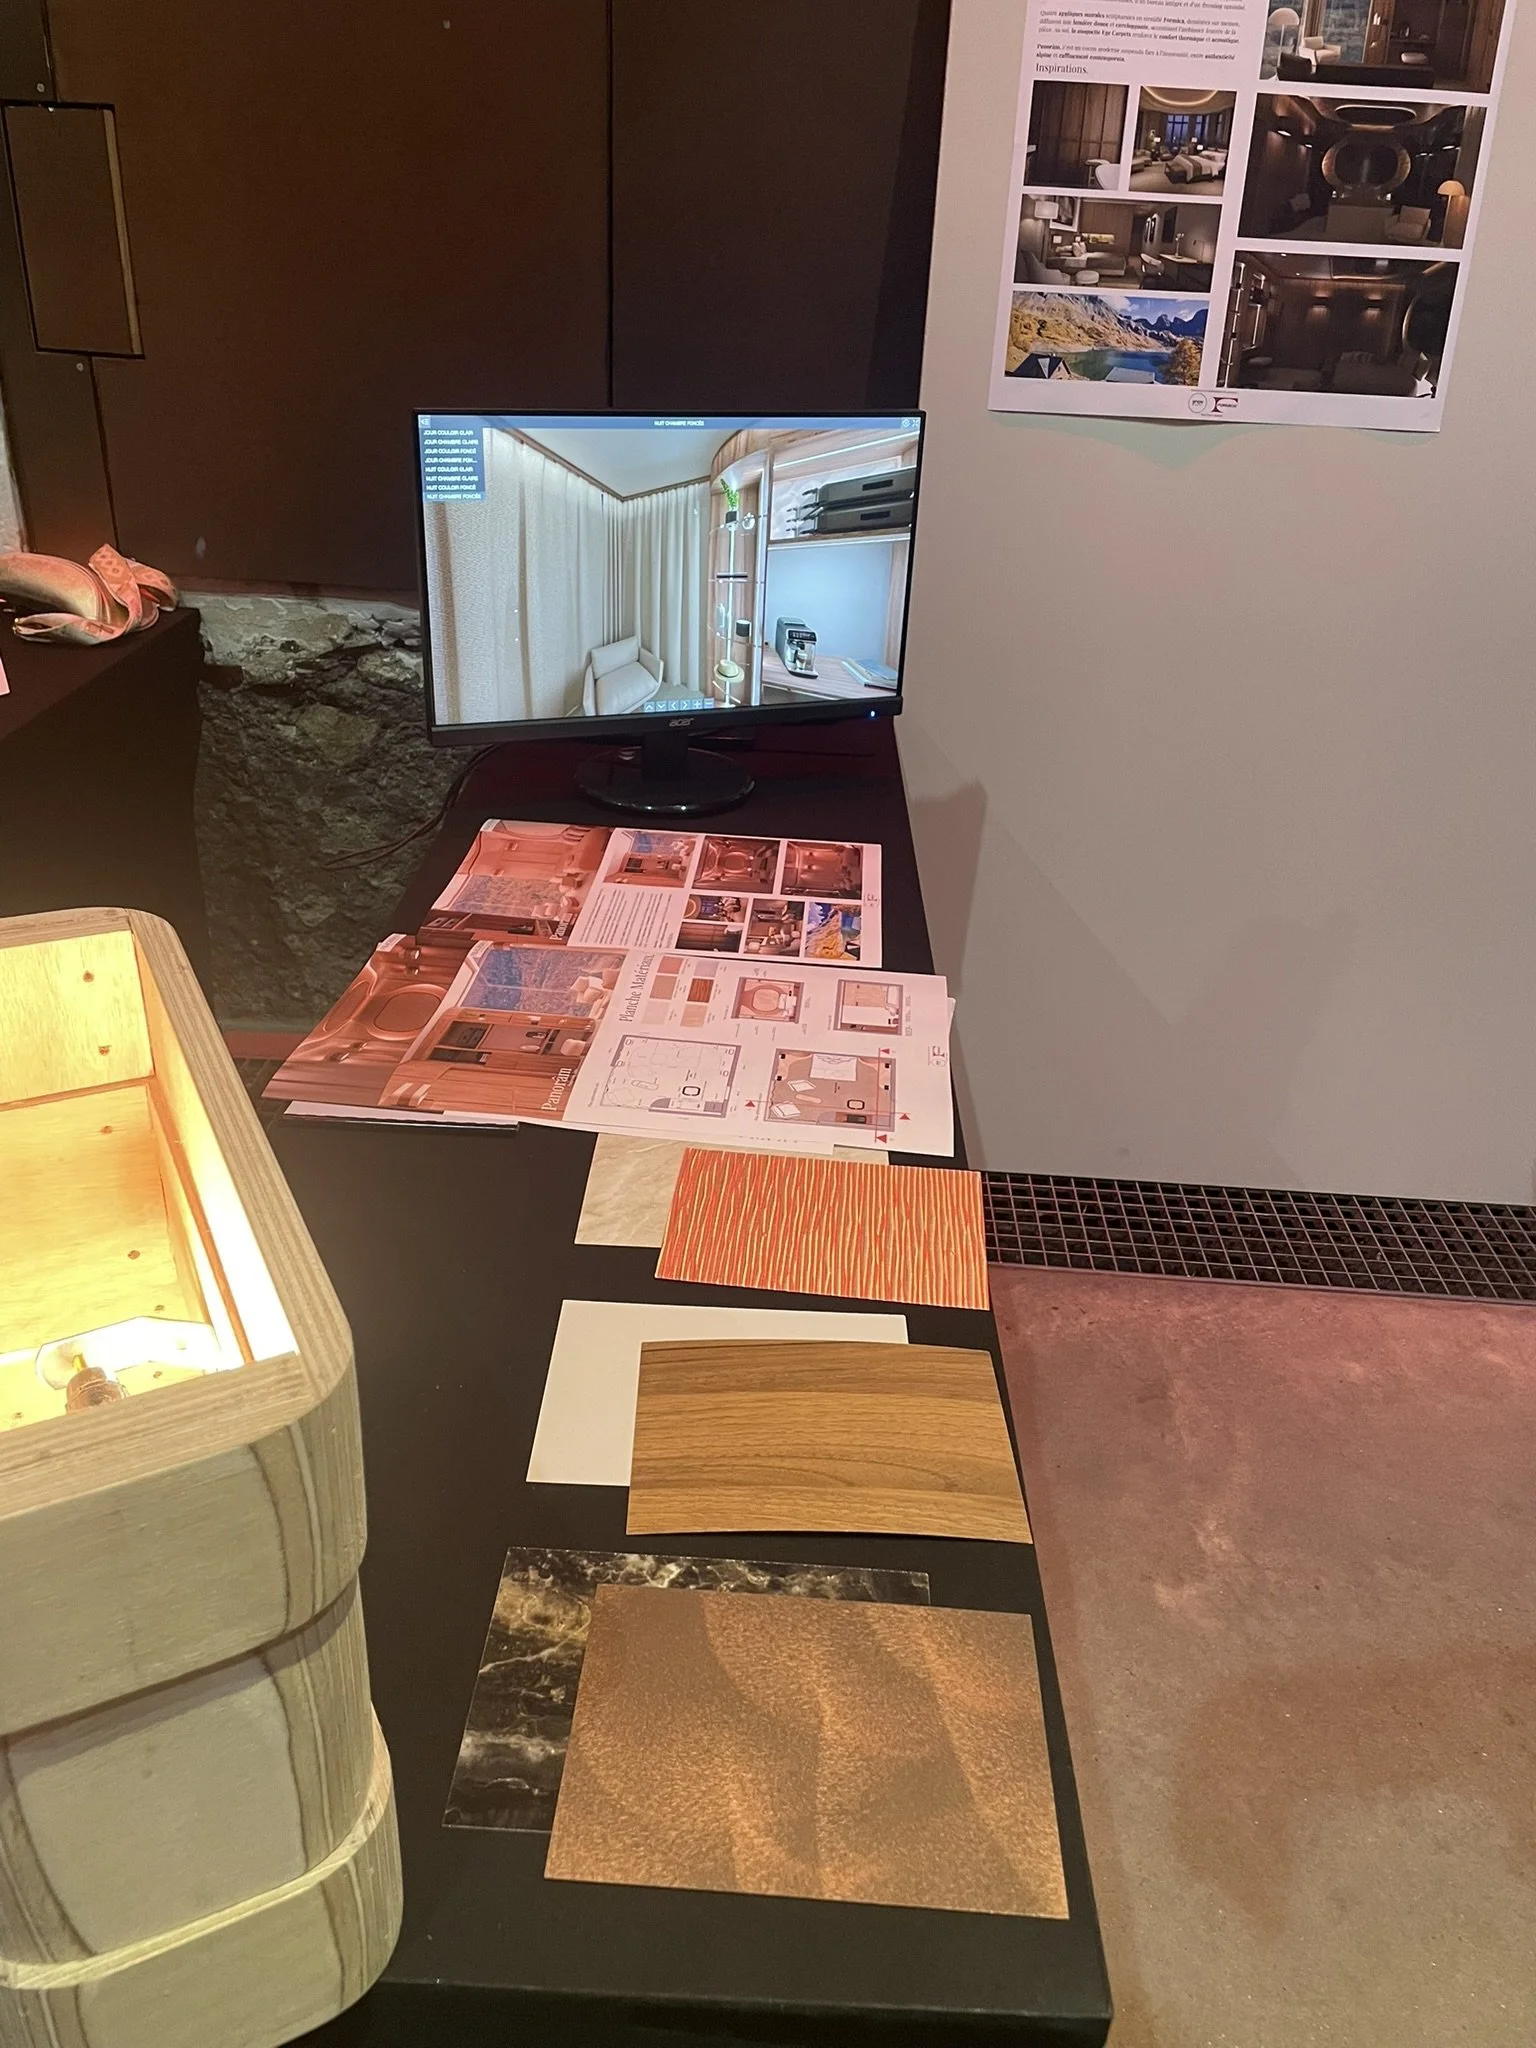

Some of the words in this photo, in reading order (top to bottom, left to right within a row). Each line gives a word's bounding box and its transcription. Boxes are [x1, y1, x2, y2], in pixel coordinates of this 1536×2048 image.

[669, 718, 694, 727] acer
[618, 990, 642, 1022] Planche
[541, 1068, 572, 1111] Panorâm
